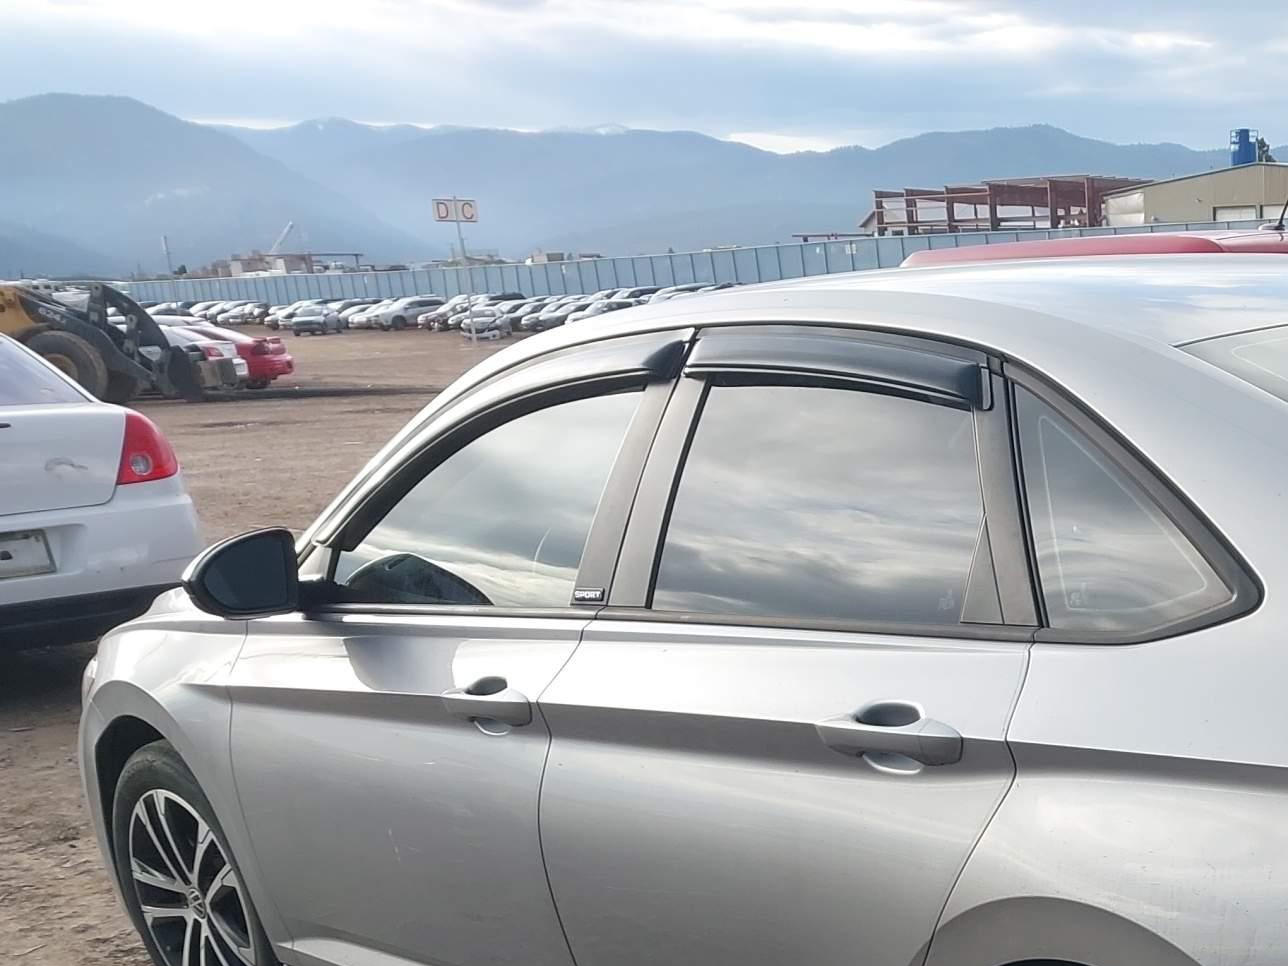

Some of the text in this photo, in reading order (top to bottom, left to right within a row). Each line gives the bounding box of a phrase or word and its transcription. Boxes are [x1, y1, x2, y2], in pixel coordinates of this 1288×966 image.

[436, 202, 474, 219] D C
[574, 590, 601, 598] SPORT
